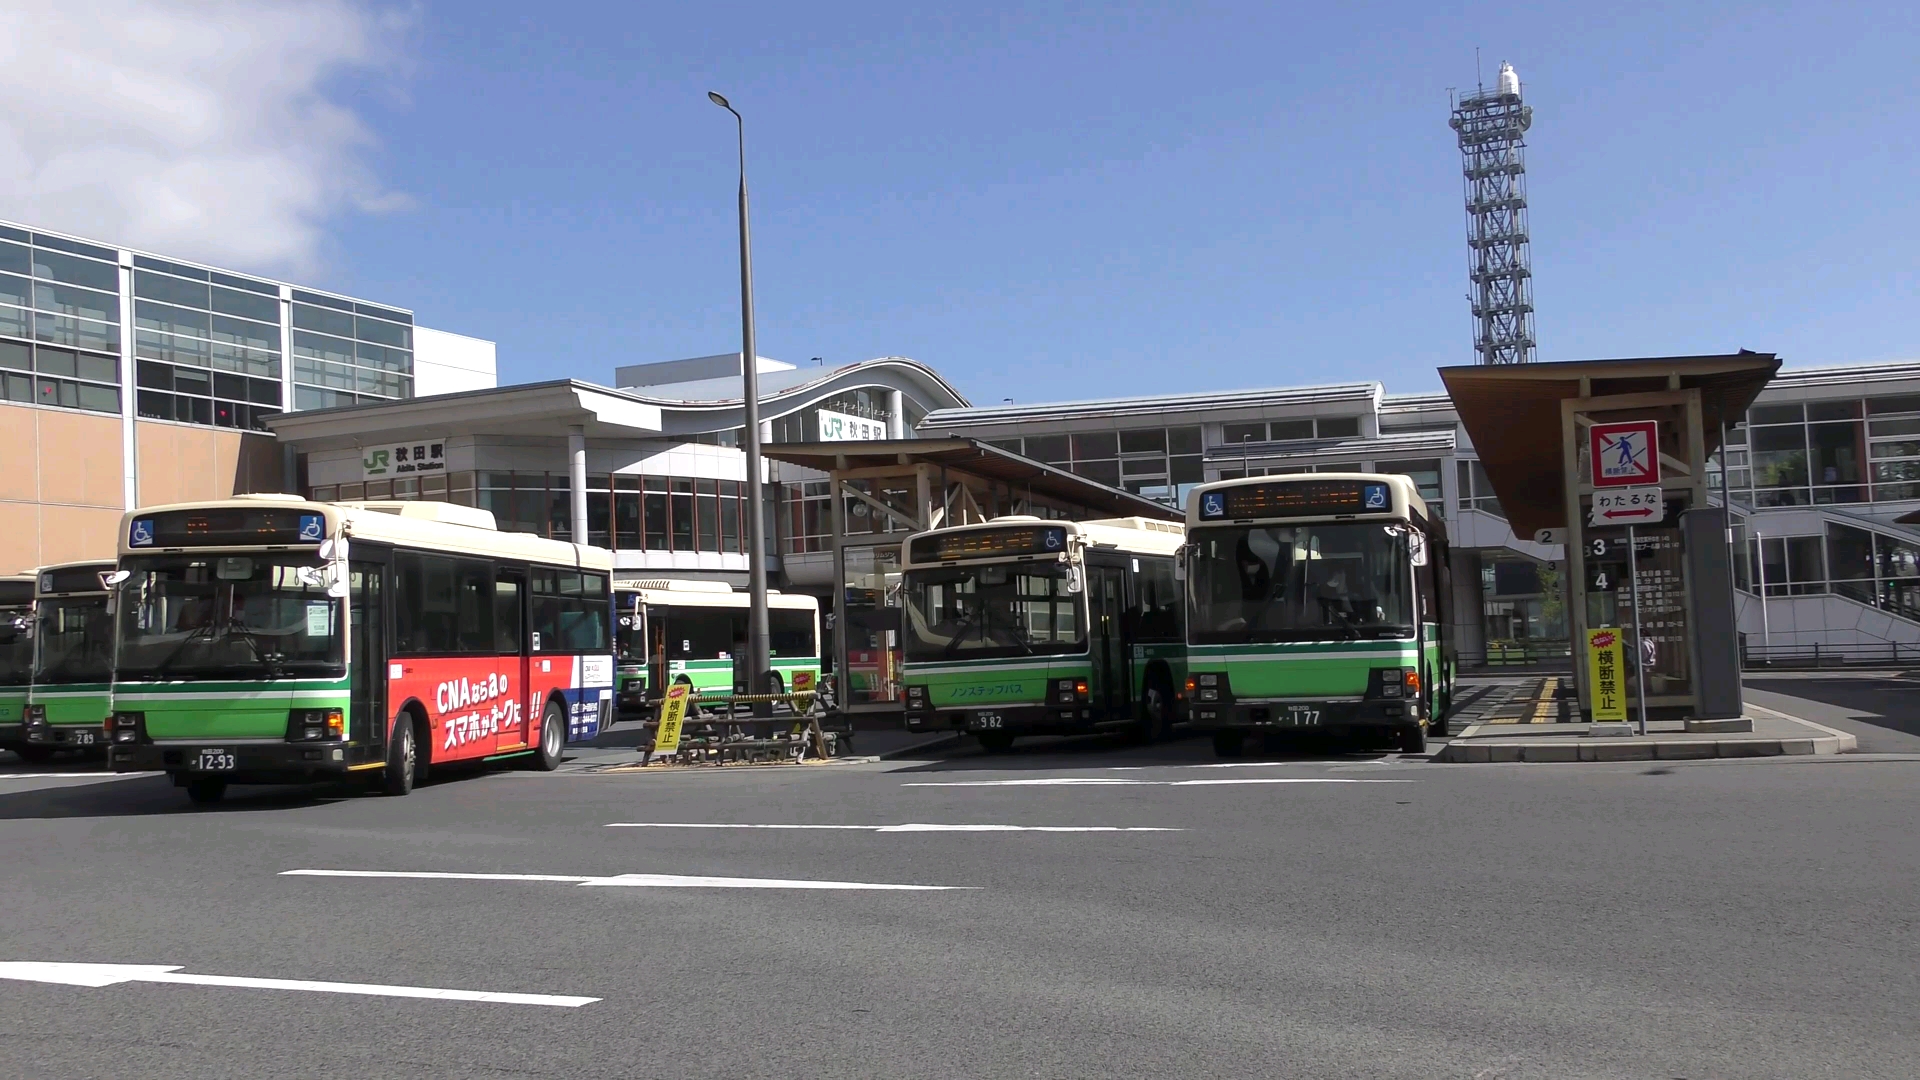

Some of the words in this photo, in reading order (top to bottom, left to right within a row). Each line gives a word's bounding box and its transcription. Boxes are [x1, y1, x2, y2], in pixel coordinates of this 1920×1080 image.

[824, 417, 843, 439] JR
[849, 421, 882, 440] 秋田駅
[363, 450, 390, 468] JR
[396, 444, 443, 462] 秋田駅
[1599, 493, 1657, 507] わたるな
[1541, 531, 1553, 543] 2
[1593, 539, 1606, 556] 3
[1548, 561, 1556, 571] 3
[1595, 572, 1608, 589] 4
[1598, 650, 1617, 710] 横断禁止
[662, 700, 681, 744] 横断禁止
[199, 754, 235, 770] 12-93
